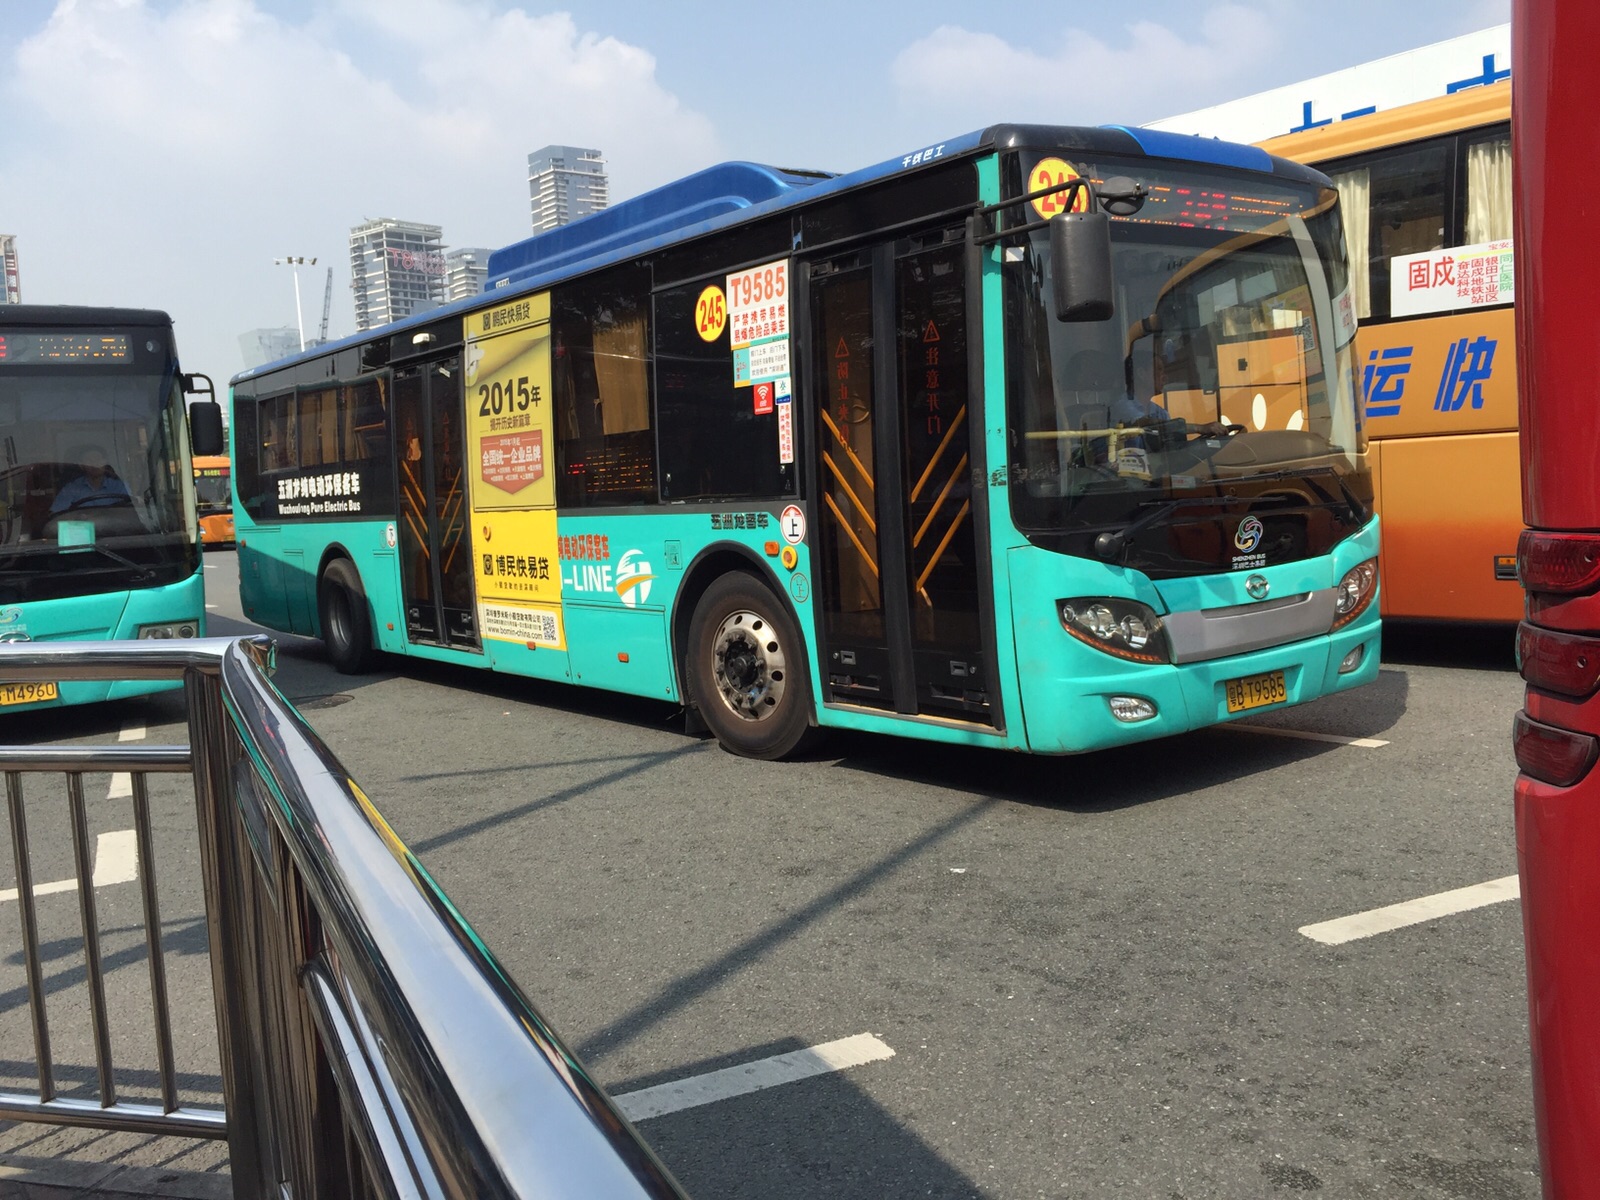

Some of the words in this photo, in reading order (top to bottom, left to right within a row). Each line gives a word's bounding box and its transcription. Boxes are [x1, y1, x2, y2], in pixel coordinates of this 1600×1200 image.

[1488, 242, 1513, 251] 宝安
[731, 266, 785, 307] T9585
[1409, 256, 1455, 291] 固戍
[1457, 261, 1470, 297] 奋达科技
[1471, 258, 1485, 304] 固戍地铁站
[1485, 256, 1499, 302] 银田工业区
[1500, 254, 1514, 291] 同仁医院
[700, 295, 723, 333] 245
[1434, 336, 1498, 412] 快
[479, 376, 541, 417] 2015年
[482, 444, 542, 467] 全国统一企业品牌
[311, 502, 324, 513] Pure
[324, 501, 348, 513] Electric
[348, 500, 360, 511] Bus
[788, 518, 799, 537] 上
[496, 554, 549, 580] 博民快易贷
[560, 564, 613, 593] -LINE
